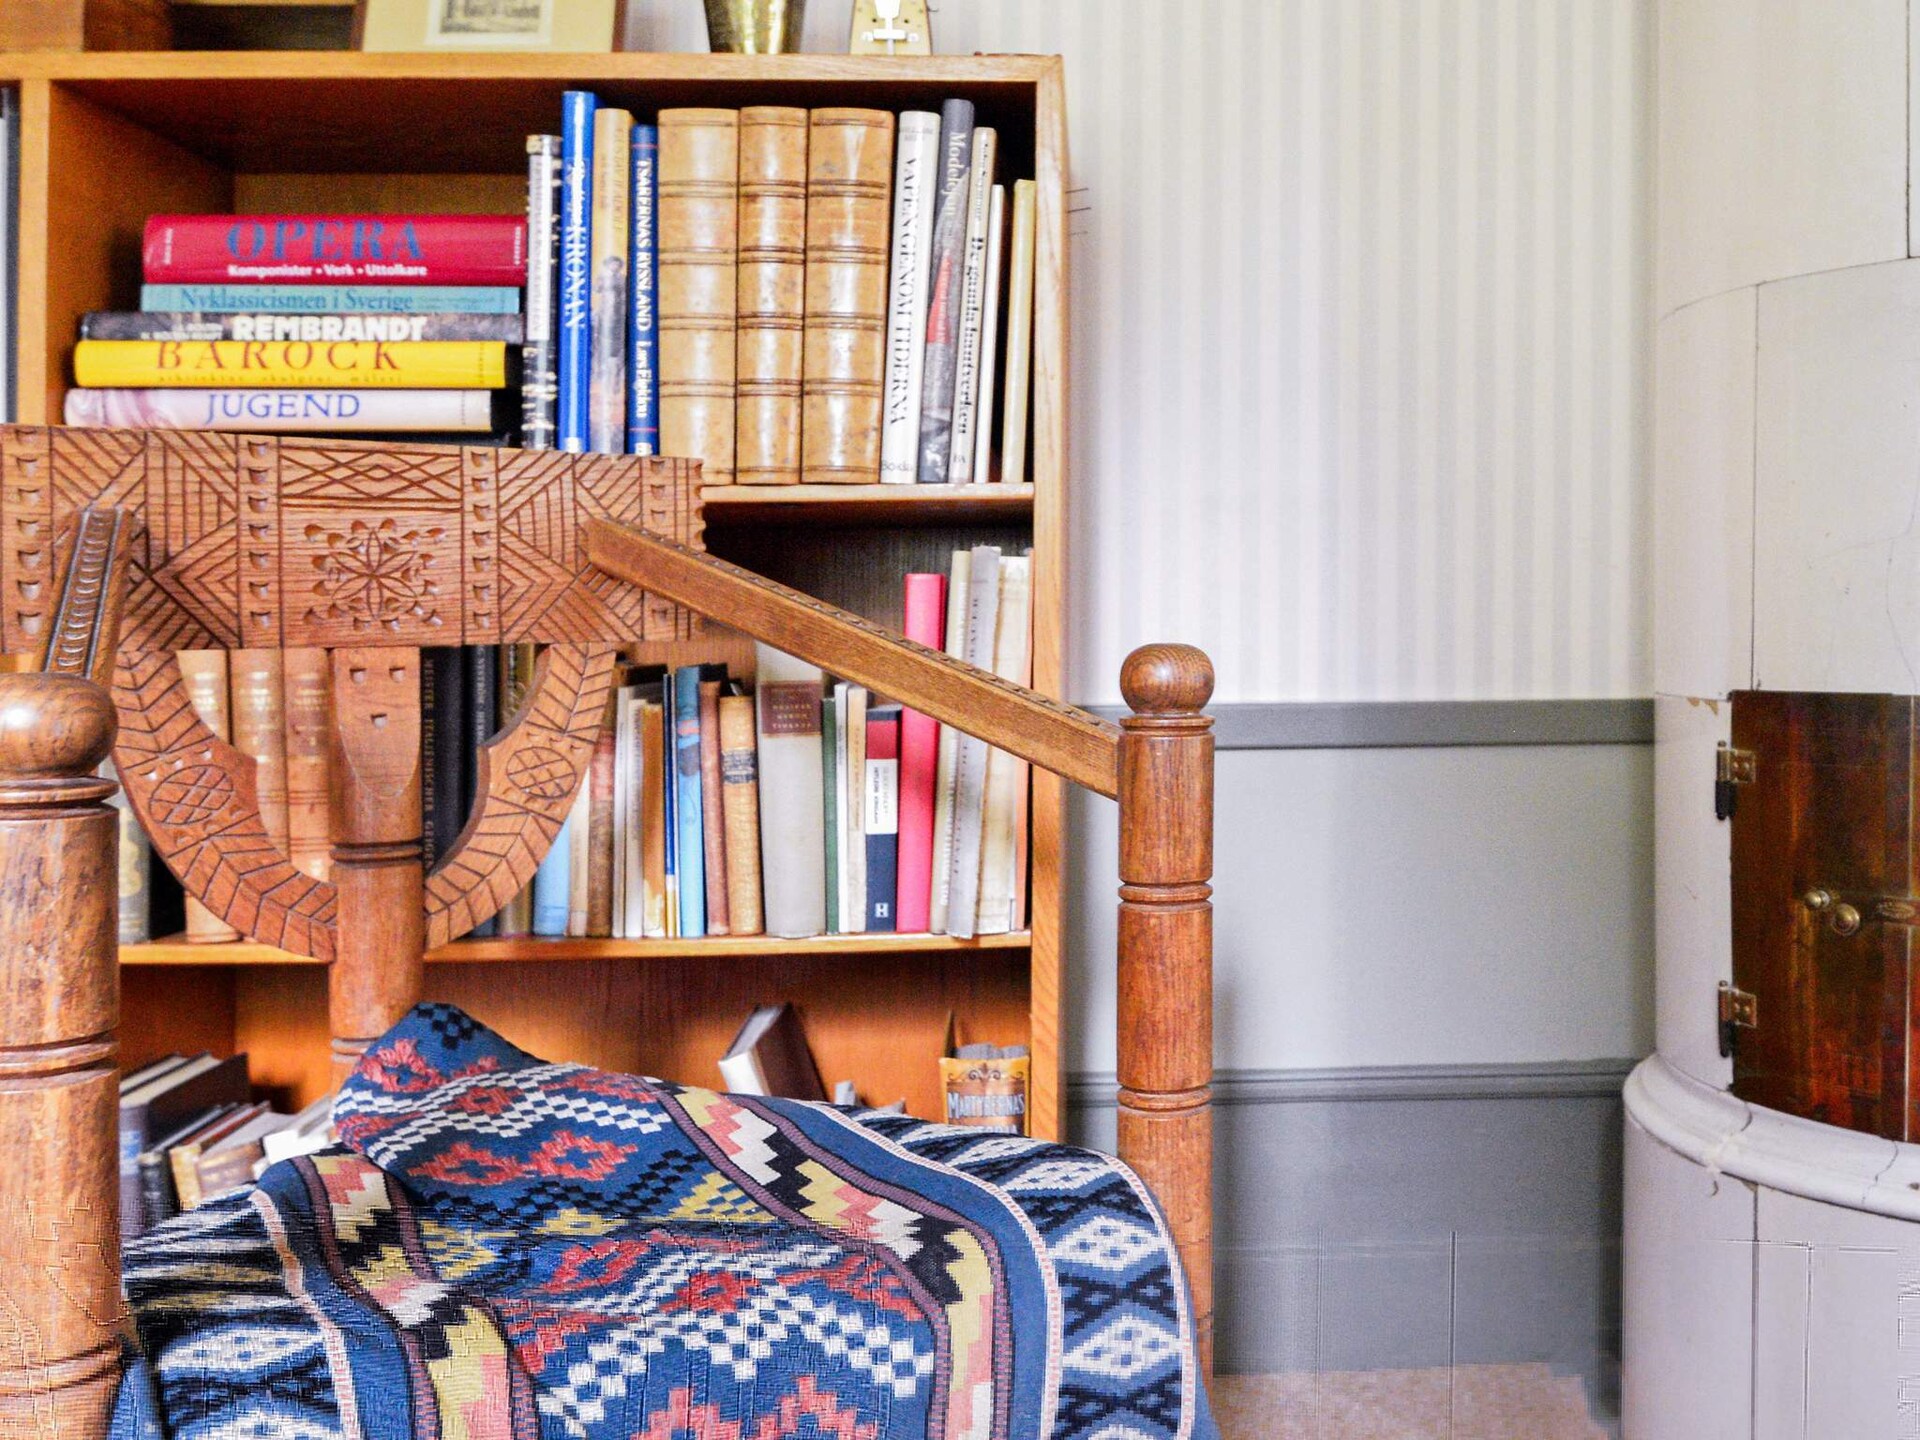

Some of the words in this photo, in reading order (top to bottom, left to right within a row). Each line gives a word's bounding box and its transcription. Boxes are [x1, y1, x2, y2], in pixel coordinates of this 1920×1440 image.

[901, 157, 919, 230] VAPEN
[226, 220, 426, 261] OPERA
[227, 264, 313, 279] Komponister
[323, 264, 355, 277] Verk
[365, 264, 428, 277] Uttolkare
[565, 225, 587, 329] KRONAN
[636, 252, 653, 332] RYSSLAND
[896, 233, 916, 316] GENOM
[180, 287, 327, 312] Nyklassicismen
[344, 287, 413, 312] Sverige
[232, 315, 428, 341] REMBRANDT
[156, 341, 401, 370] BAROCK
[890, 321, 912, 425] TIDERNA
[205, 393, 361, 424] JUGEND
